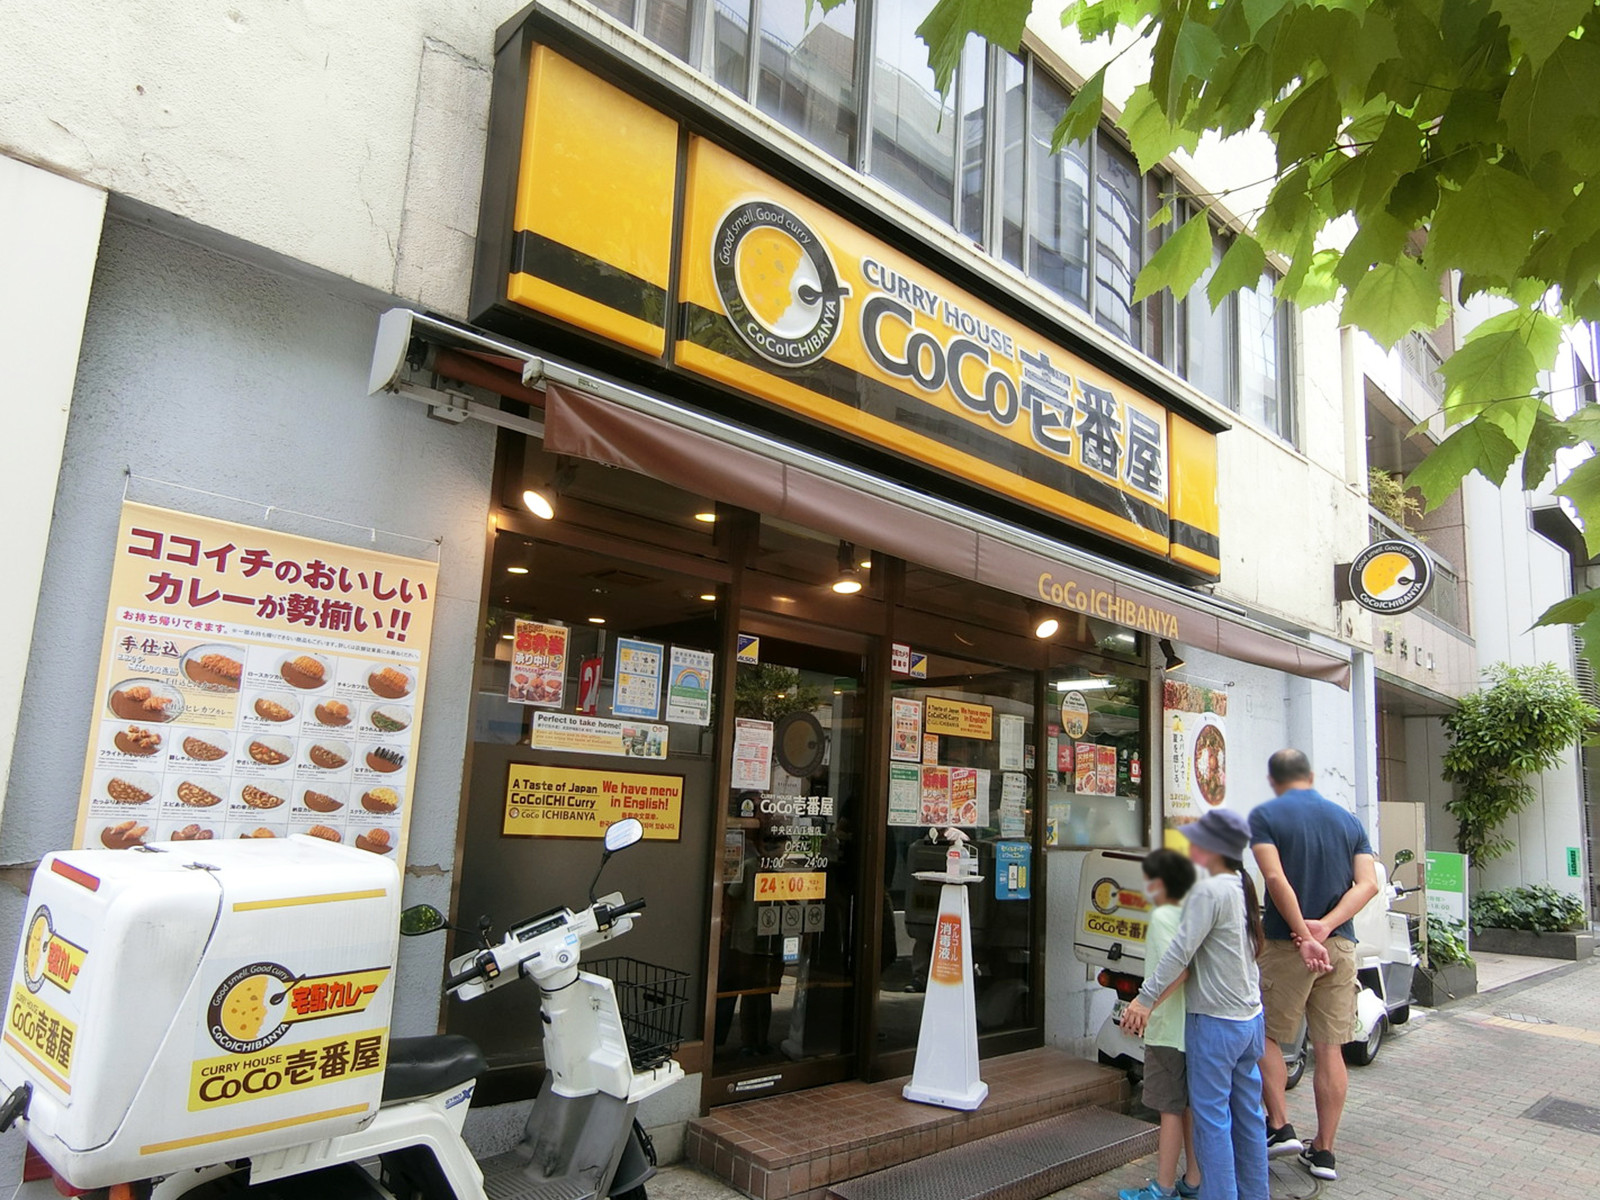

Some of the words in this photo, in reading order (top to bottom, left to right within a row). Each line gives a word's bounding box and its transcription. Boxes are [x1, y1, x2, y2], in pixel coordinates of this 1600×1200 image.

[720, 230, 735, 265] Good
[756, 207, 784, 224] Good
[786, 219, 811, 244] curry
[862, 259, 939, 316] CURRY
[943, 301, 1014, 359] HOUSE
[747, 300, 836, 357] CoCoICHIBANYA
[862, 295, 1164, 502] CoCo壱番屋
[127, 527, 428, 604] ココイチのおいしい
[1355, 555, 1368, 572] Good
[1384, 544, 1403, 552] Good
[1402, 547, 1417, 559] curry
[145, 571, 412, 643] カレーが勢揃い!!
[1038, 572, 1088, 611] CoCo
[1090, 588, 1180, 640] ICHIBANYA
[1360, 582, 1422, 608] CoCoICHIBANYA
[123, 610, 228, 634] お持ち帰りできます。
[120, 635, 180, 658] 手仕込
[538, 714, 567, 724] Perfect
[569, 716, 577, 725] to
[580, 718, 596, 727] take
[598, 720, 622, 730] home!
[511, 793, 565, 806] CoCoICHI
[567, 796, 596, 809] Curry
[513, 779, 520, 789] A
[523, 779, 553, 791] Taste
[555, 782, 566, 791] of
[568, 783, 598, 794] Japan
[602, 780, 618, 793] We
[621, 782, 647, 795] have
[650, 786, 679, 797] menu
[521, 811, 539, 819] CoCo
[542, 810, 596, 821] ICHIBANYA
[610, 795, 621, 808] in
[623, 796, 669, 810] English!
[760, 795, 834, 816] CoCo壱番屋
[761, 857, 785, 869] 11:00
[804, 857, 828, 868] 24:00
[938, 922, 952, 960] 消毒液
[951, 923, 960, 961] アルコール
[212, 985, 229, 1006] Good
[250, 964, 271, 973] Good
[271, 967, 289, 981] curry
[291, 981, 378, 1015] 宅配カレー
[12, 1003, 74, 1069] CoCo壱番屋
[211, 1023, 289, 1052] CoCoICHIBANYA
[199, 1035, 382, 1102] CoCo壱番屋
[201, 1062, 240, 1077] CURRY
[243, 1054, 282, 1070] HOUSE
